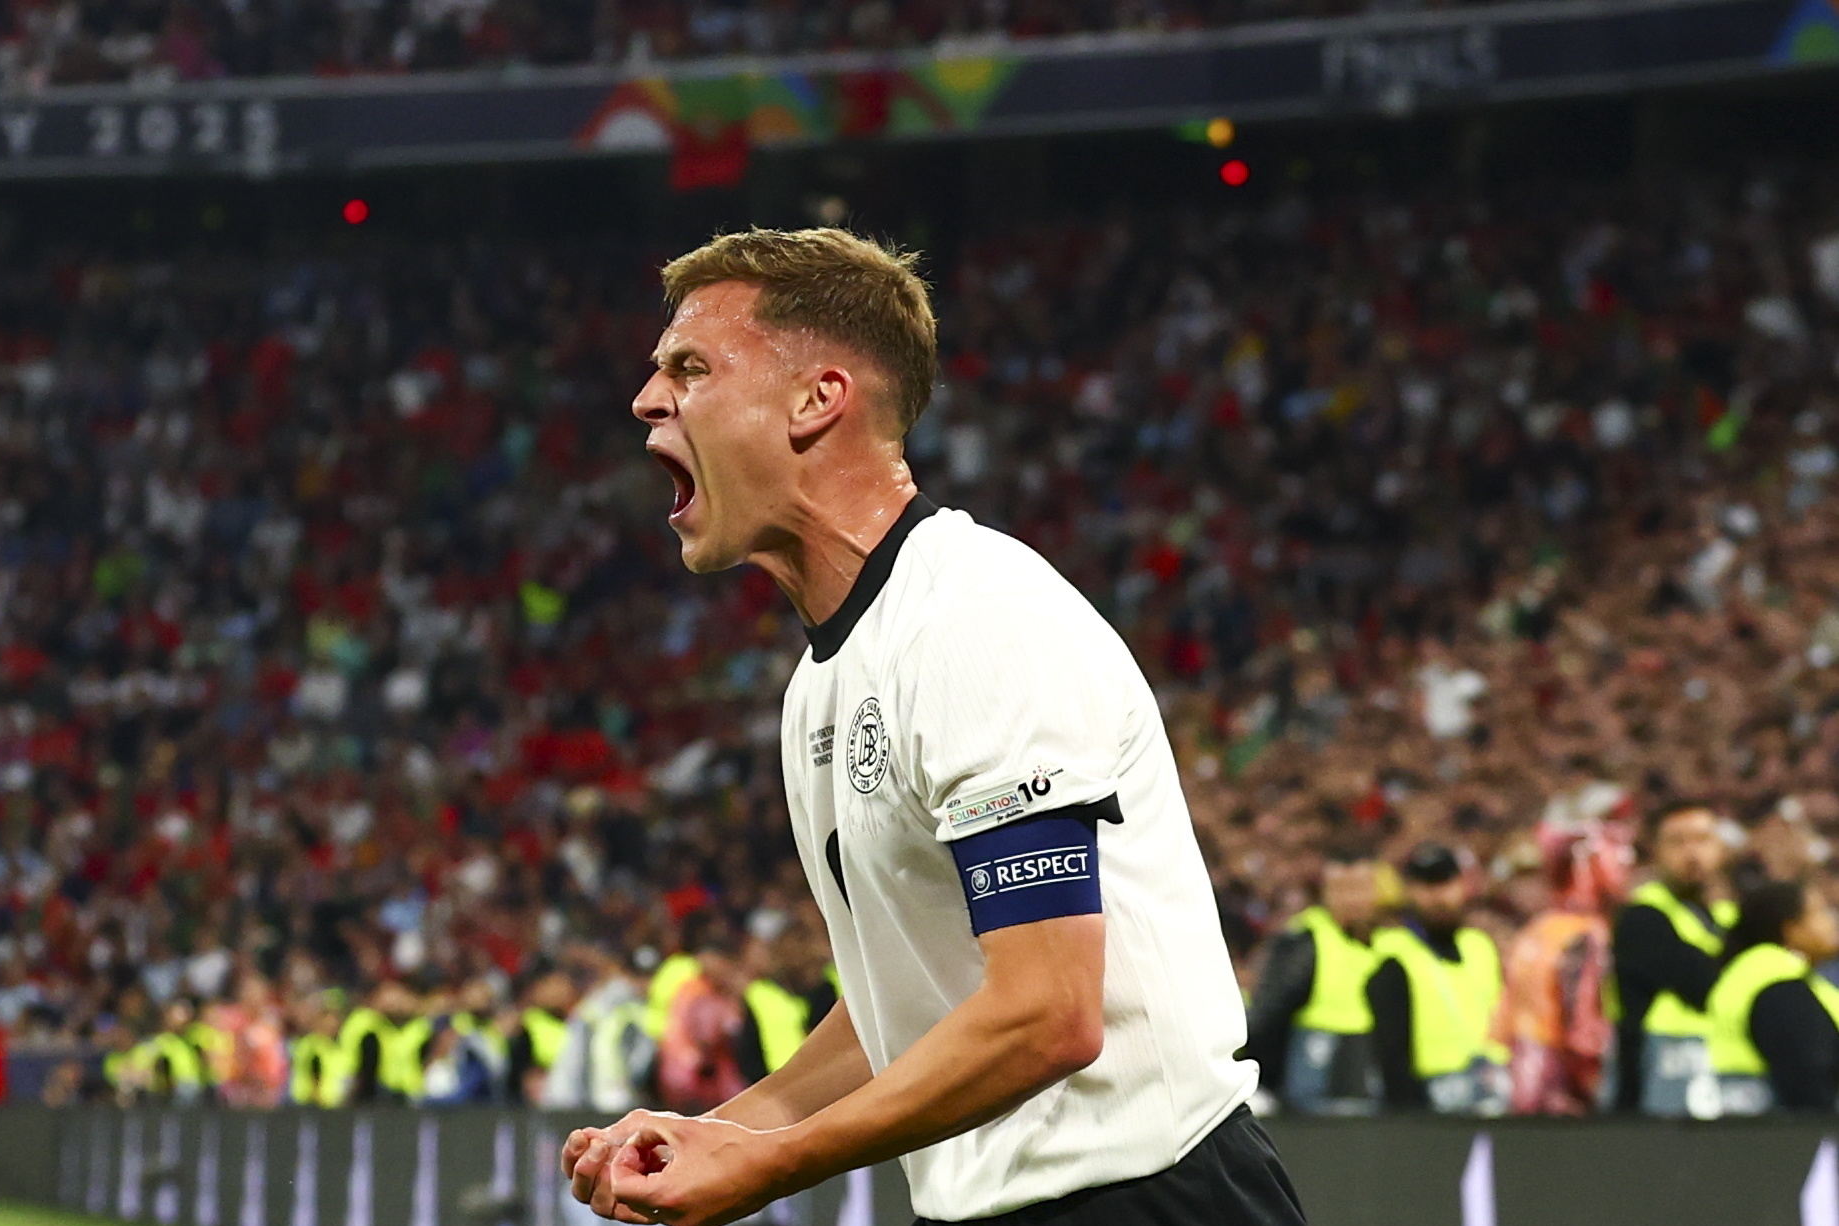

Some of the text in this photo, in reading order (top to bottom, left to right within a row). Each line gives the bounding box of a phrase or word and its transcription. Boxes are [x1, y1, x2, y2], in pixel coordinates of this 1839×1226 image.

[1018, 777, 1051, 803] 10
[948, 794, 1020, 824] FOUNDATION
[996, 853, 1088, 885] RESPECT
